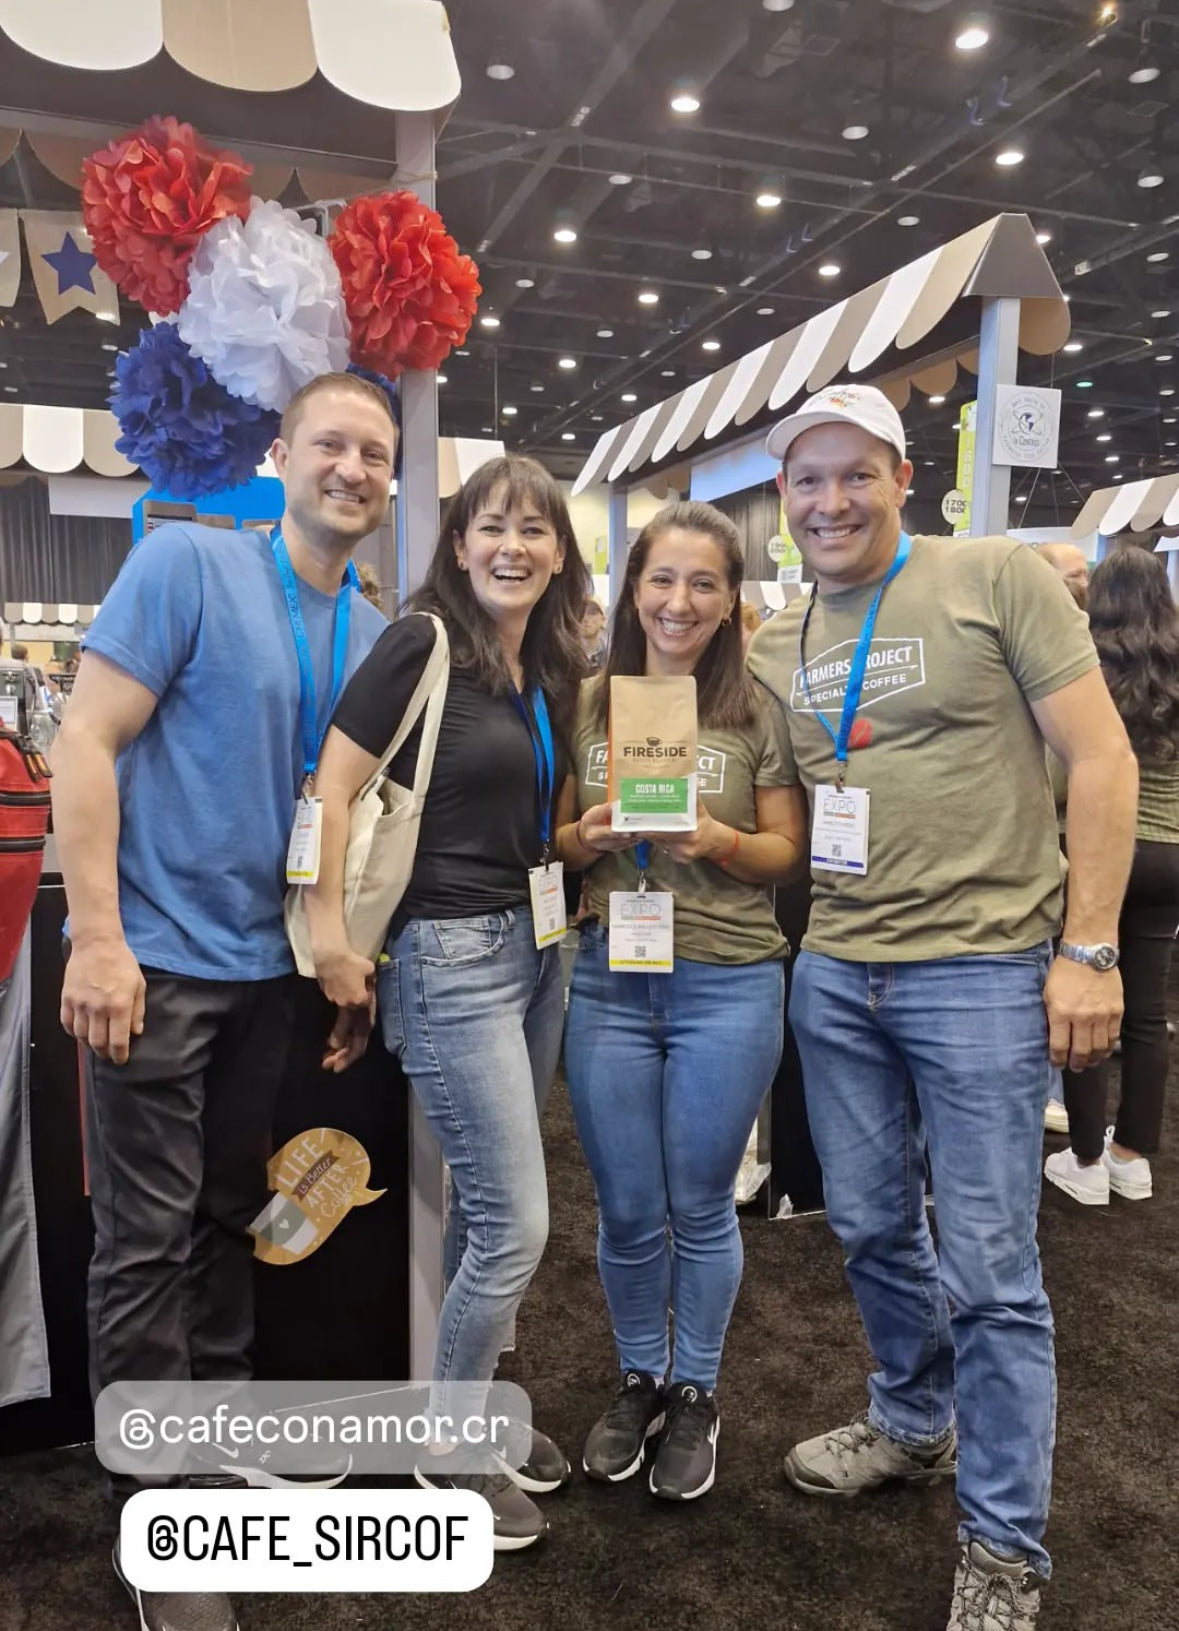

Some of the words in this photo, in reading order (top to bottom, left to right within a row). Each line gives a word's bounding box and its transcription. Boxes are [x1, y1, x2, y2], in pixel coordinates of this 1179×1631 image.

[866, 646, 912, 669] OJECT
[803, 686, 847, 705] SPECIAL
[862, 673, 906, 690] COFFEE
[623, 746, 687, 758] FIRESIDE
[635, 784, 657, 794] COSTA
[276, 1137, 324, 1188] LIFE
[305, 1157, 331, 1184] Better
[306, 1163, 349, 1208] AFTER
